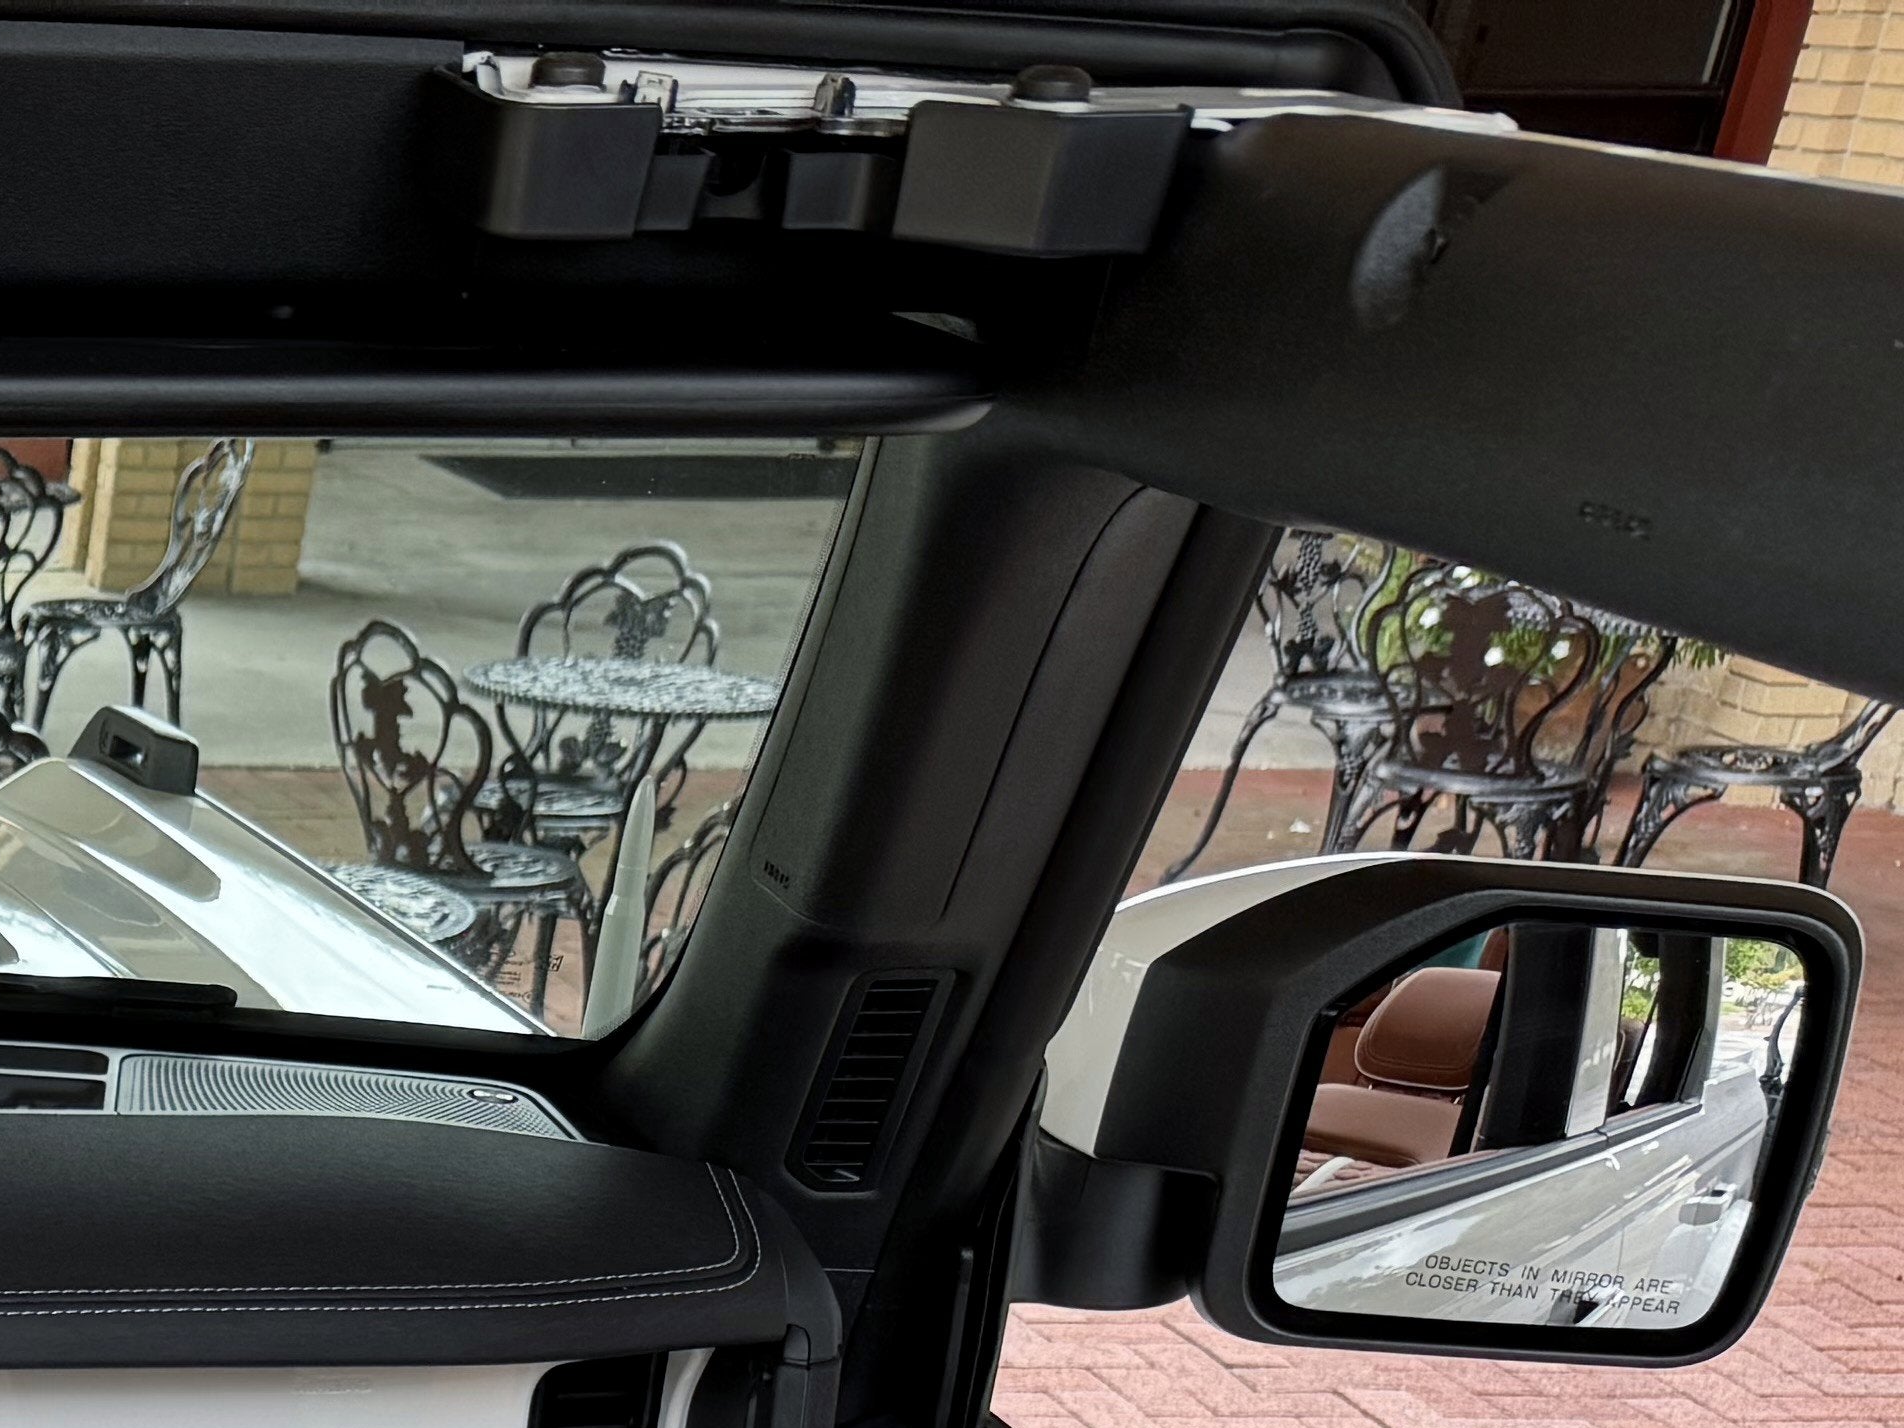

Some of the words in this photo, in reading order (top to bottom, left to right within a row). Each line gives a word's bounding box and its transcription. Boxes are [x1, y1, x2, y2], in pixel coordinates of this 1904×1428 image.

[1405, 1272, 1479, 1292] CLOSER
[1490, 1281, 1539, 1299] THAN
[1551, 1288, 1598, 1304] THEY
[1425, 1255, 1510, 1277] OBJECTS
[1521, 1265, 1540, 1280] IN
[1551, 1269, 1624, 1289] MIRROR
[1633, 1278, 1673, 1294] ARE
